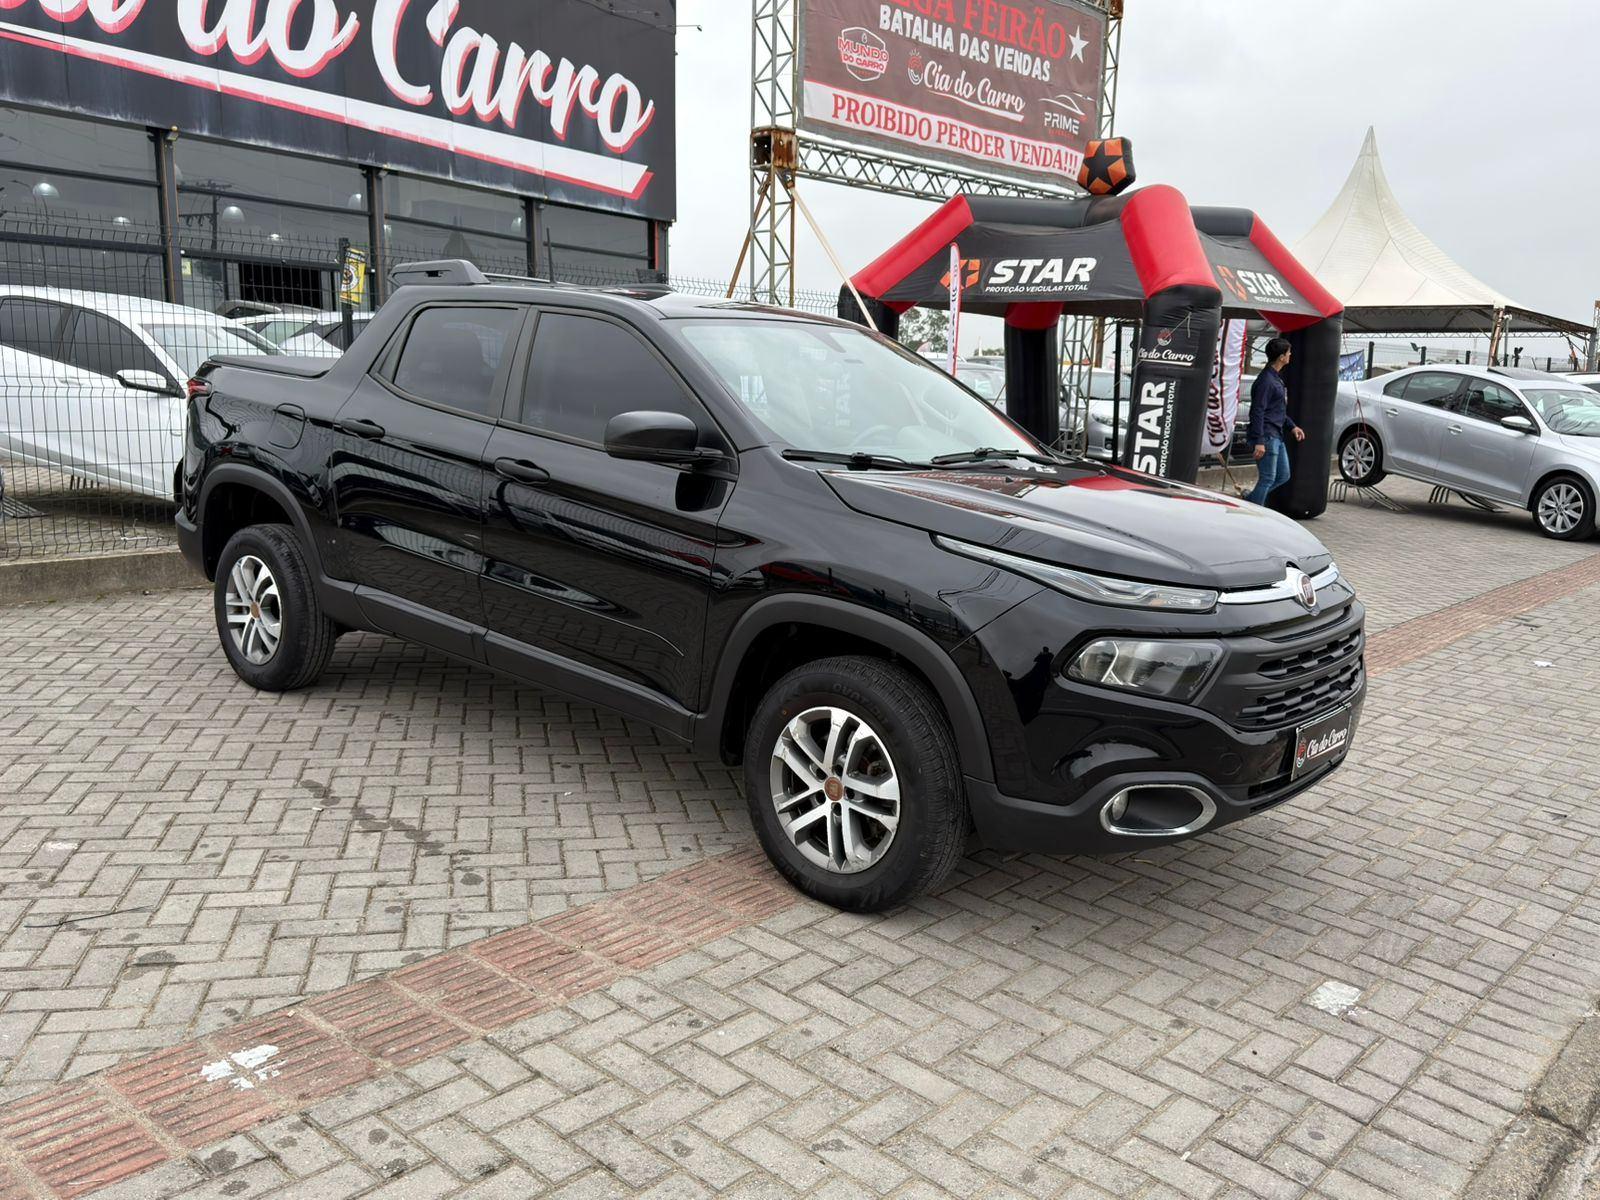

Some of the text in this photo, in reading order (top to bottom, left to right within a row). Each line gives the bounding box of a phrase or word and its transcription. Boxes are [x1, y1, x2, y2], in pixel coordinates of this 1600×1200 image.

[879, 4, 1051, 82] BATALHA DAS VENDAS
[963, 0, 1066, 60] FEIRÃO
[838, 37, 889, 62] MUNDO
[843, 53, 885, 72] DO CARRO
[371, 0, 654, 153] Carro
[923, 60, 1026, 112] Cia do Carro
[831, 93, 1079, 176] PROIBIDO PERDER VENDA!!!
[1044, 111, 1080, 136] PRIME
[988, 257, 1098, 284] STAR
[1236, 270, 1289, 297] STAR
[985, 284, 1088, 294] PROTEÇÃO VEICULAR TOTAL
[1148, 348, 1161, 359] do
[1161, 349, 1195, 362] Carro
[1132, 381, 1167, 475] STAR
[1159, 381, 1177, 477] PROTEÇÃO VEICULAR TOTAL
[1207, 413, 1226, 446] Cia
[1307, 728, 1347, 758] Cia do Carro
